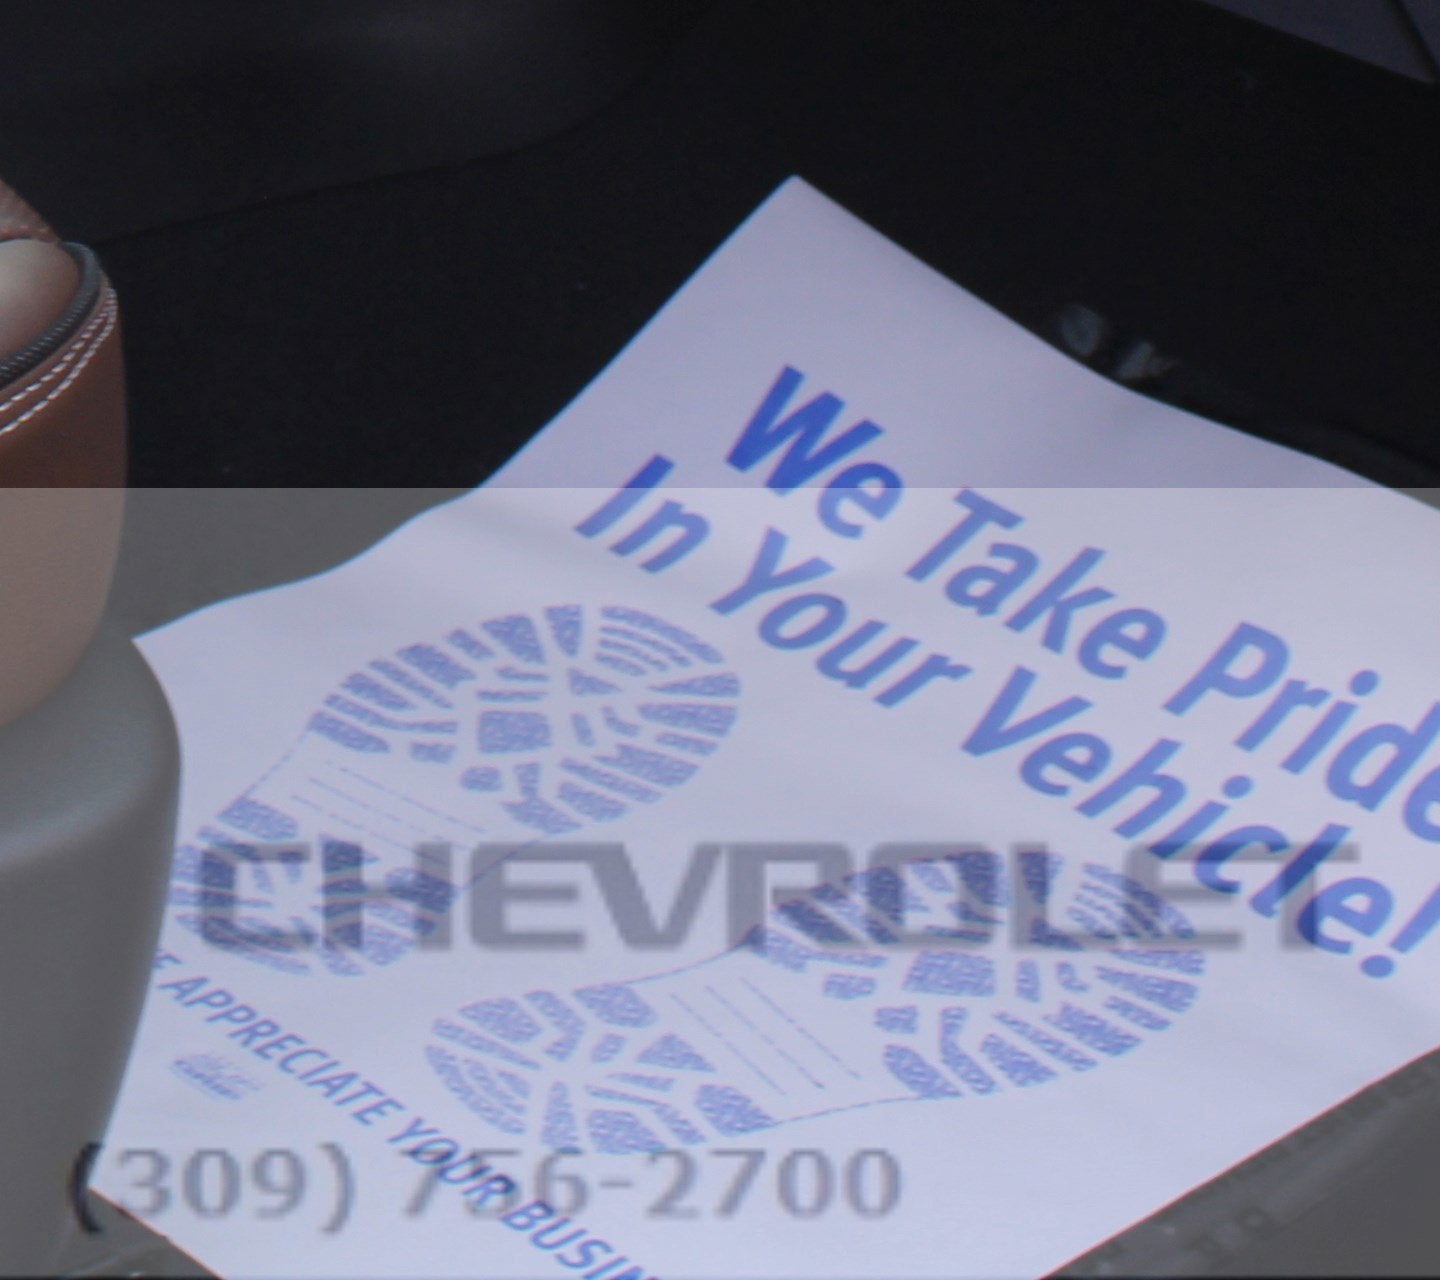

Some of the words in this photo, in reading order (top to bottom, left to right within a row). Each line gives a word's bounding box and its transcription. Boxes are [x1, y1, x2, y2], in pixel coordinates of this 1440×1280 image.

[573, 453, 712, 575] In
[708, 527, 973, 709] Your
[724, 365, 906, 540] We
[904, 487, 1168, 681] Take
[158, 976, 407, 1126] APPRECIATE
[386, 1117, 519, 1213] YOUR
